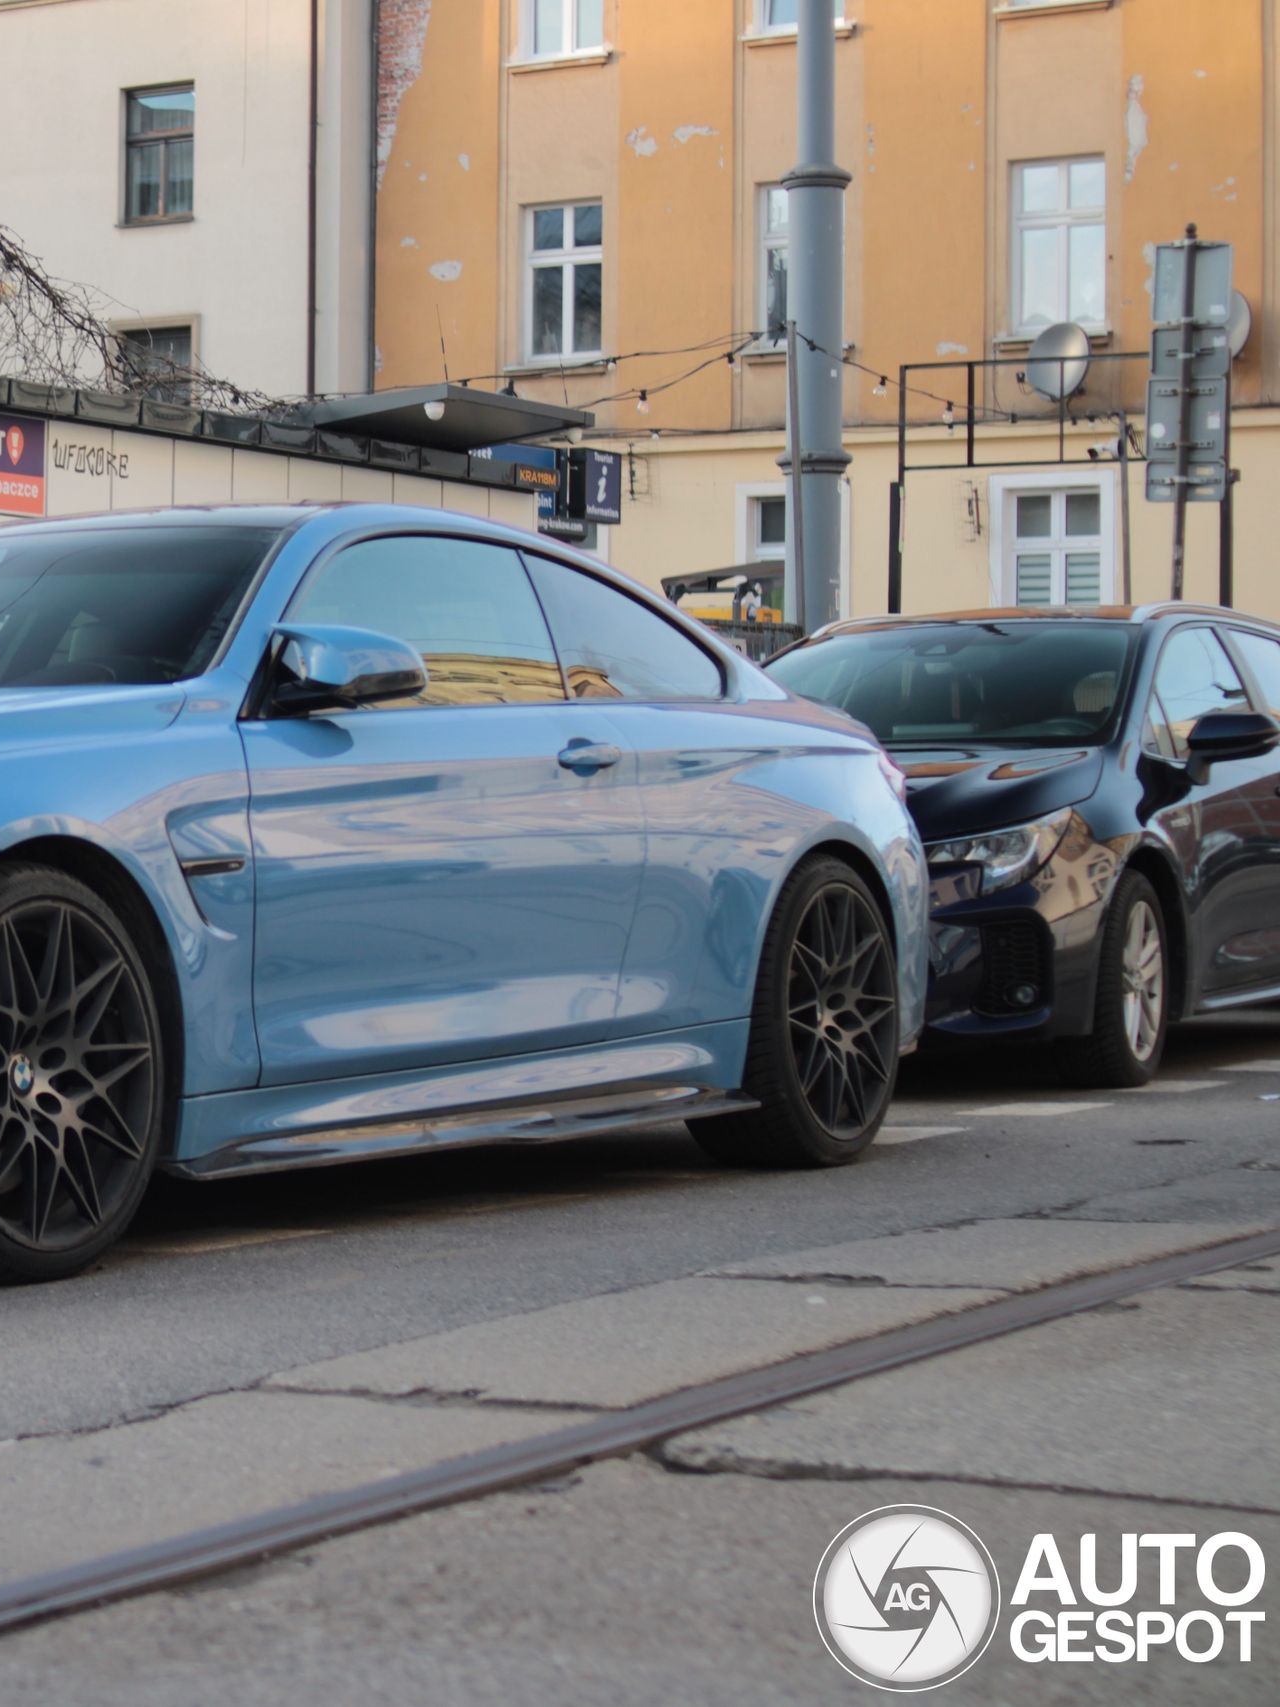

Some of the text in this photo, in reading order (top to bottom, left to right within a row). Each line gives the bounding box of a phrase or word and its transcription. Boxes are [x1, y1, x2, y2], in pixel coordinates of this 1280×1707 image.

[593, 451, 614, 464] Tourist
[519, 468, 557, 487] KRA118M
[586, 504, 619, 519] Information
